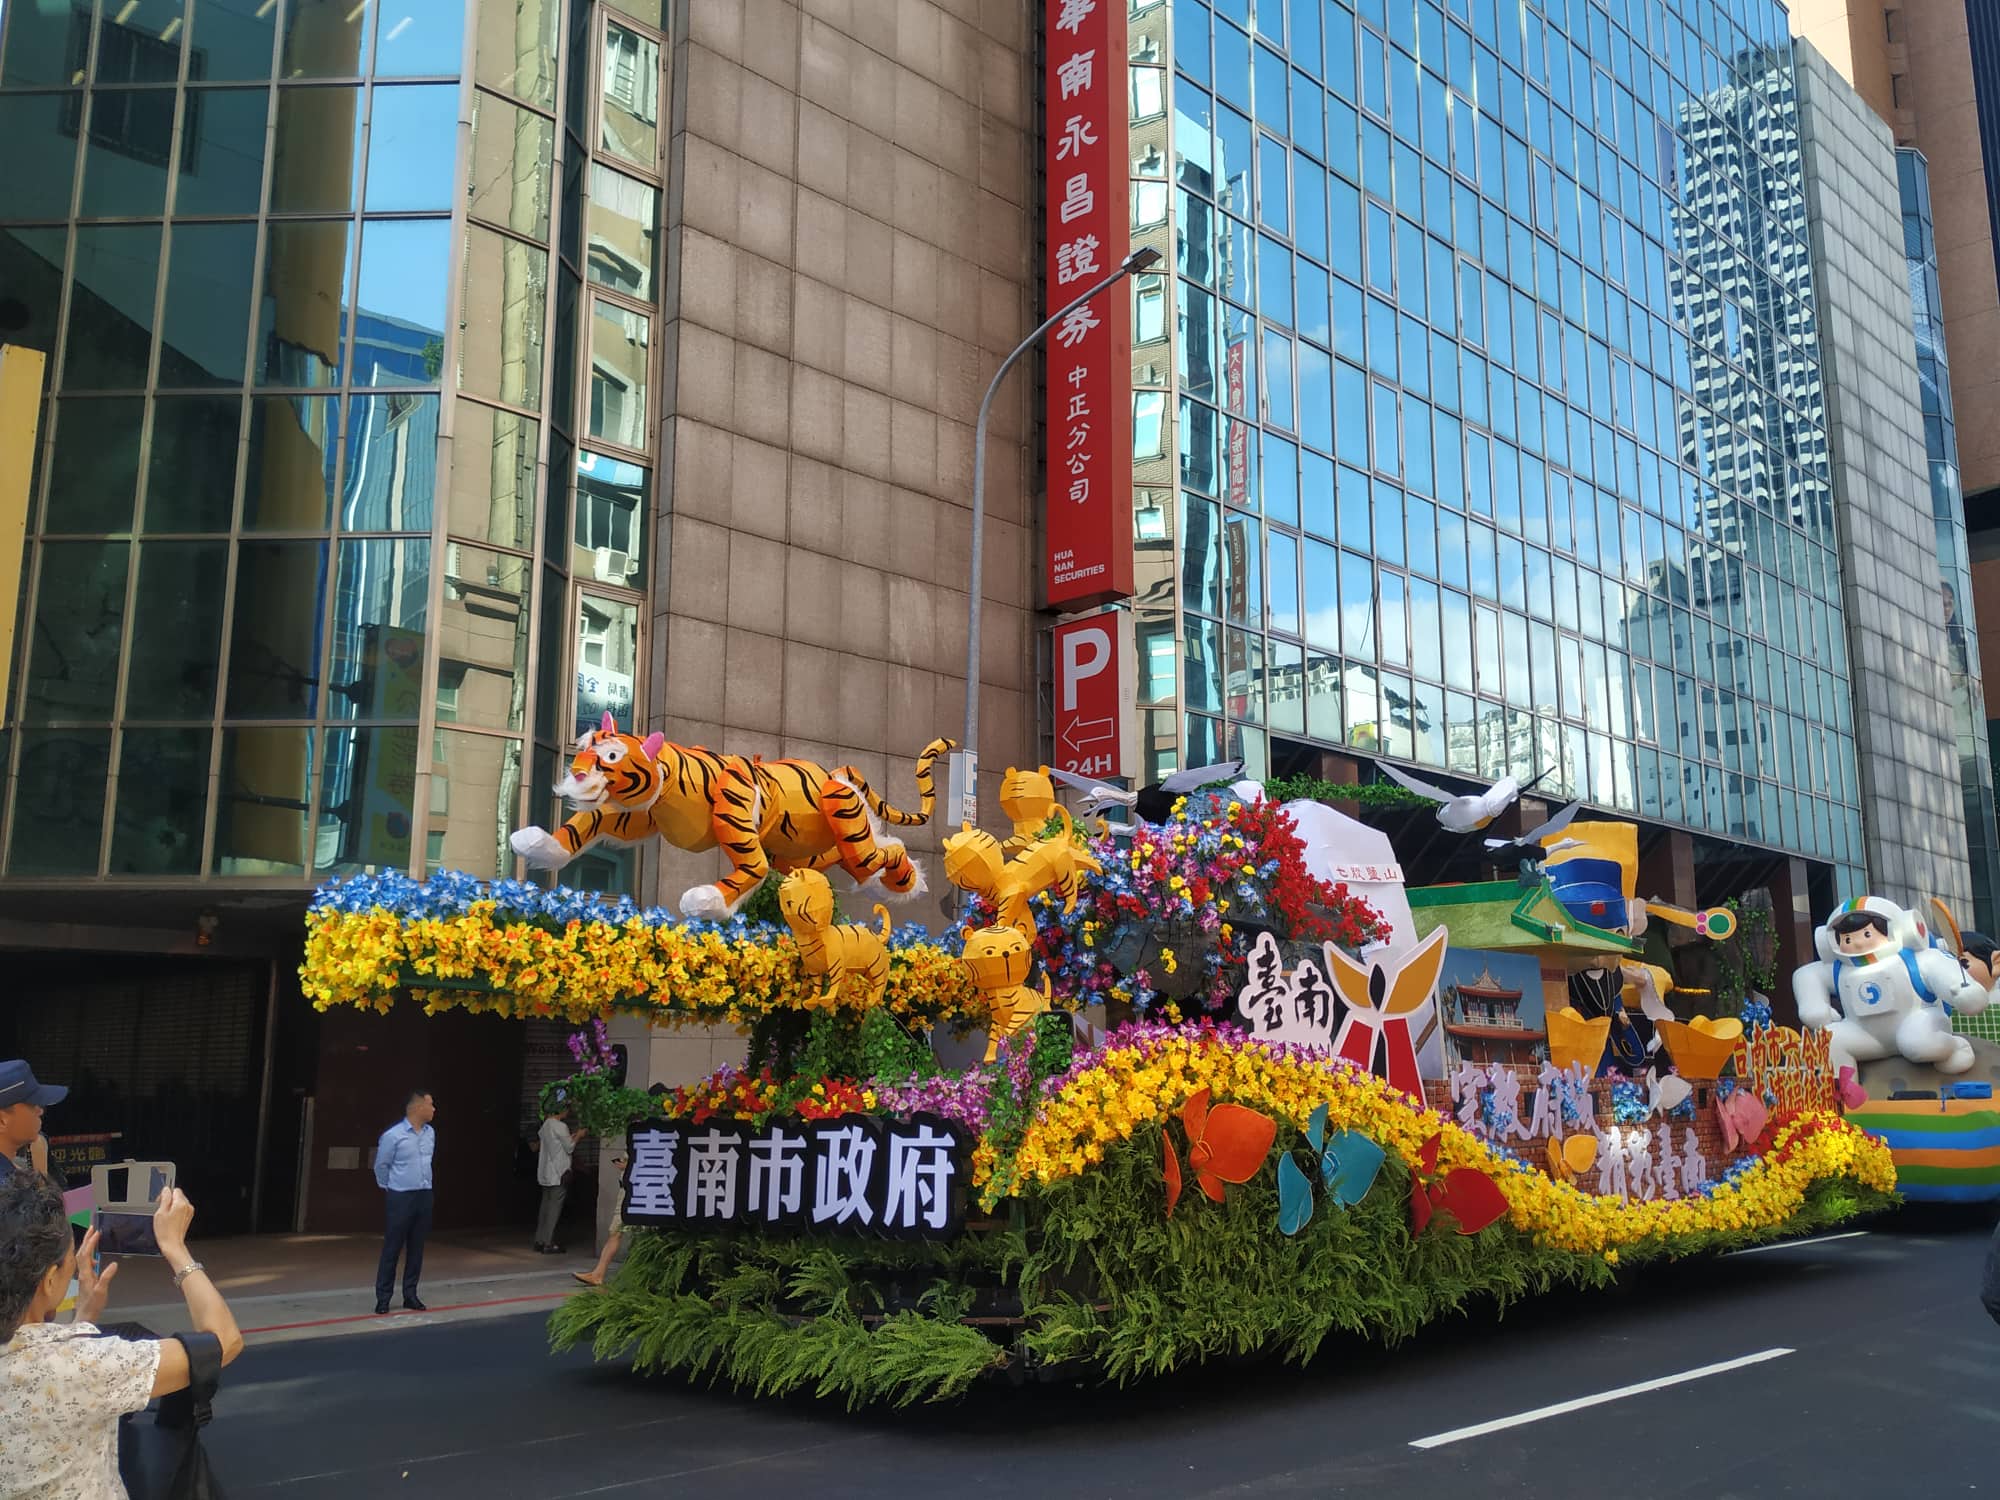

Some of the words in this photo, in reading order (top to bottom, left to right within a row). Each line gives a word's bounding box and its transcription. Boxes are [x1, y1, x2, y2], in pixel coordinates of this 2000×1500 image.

[1056, 0, 1101, 348] 華南永昌證券
[1066, 365, 1092, 505] 中正分公司
[1054, 549, 1074, 562] HUA
[1054, 560, 1075, 573] NAN
[1054, 563, 1105, 584] SECURITIES
[1062, 627, 1112, 712] P
[1065, 753, 1112, 776] 24H
[1249, 941, 1330, 1032] 臺南
[626, 1125, 957, 1229] 臺南市政府
